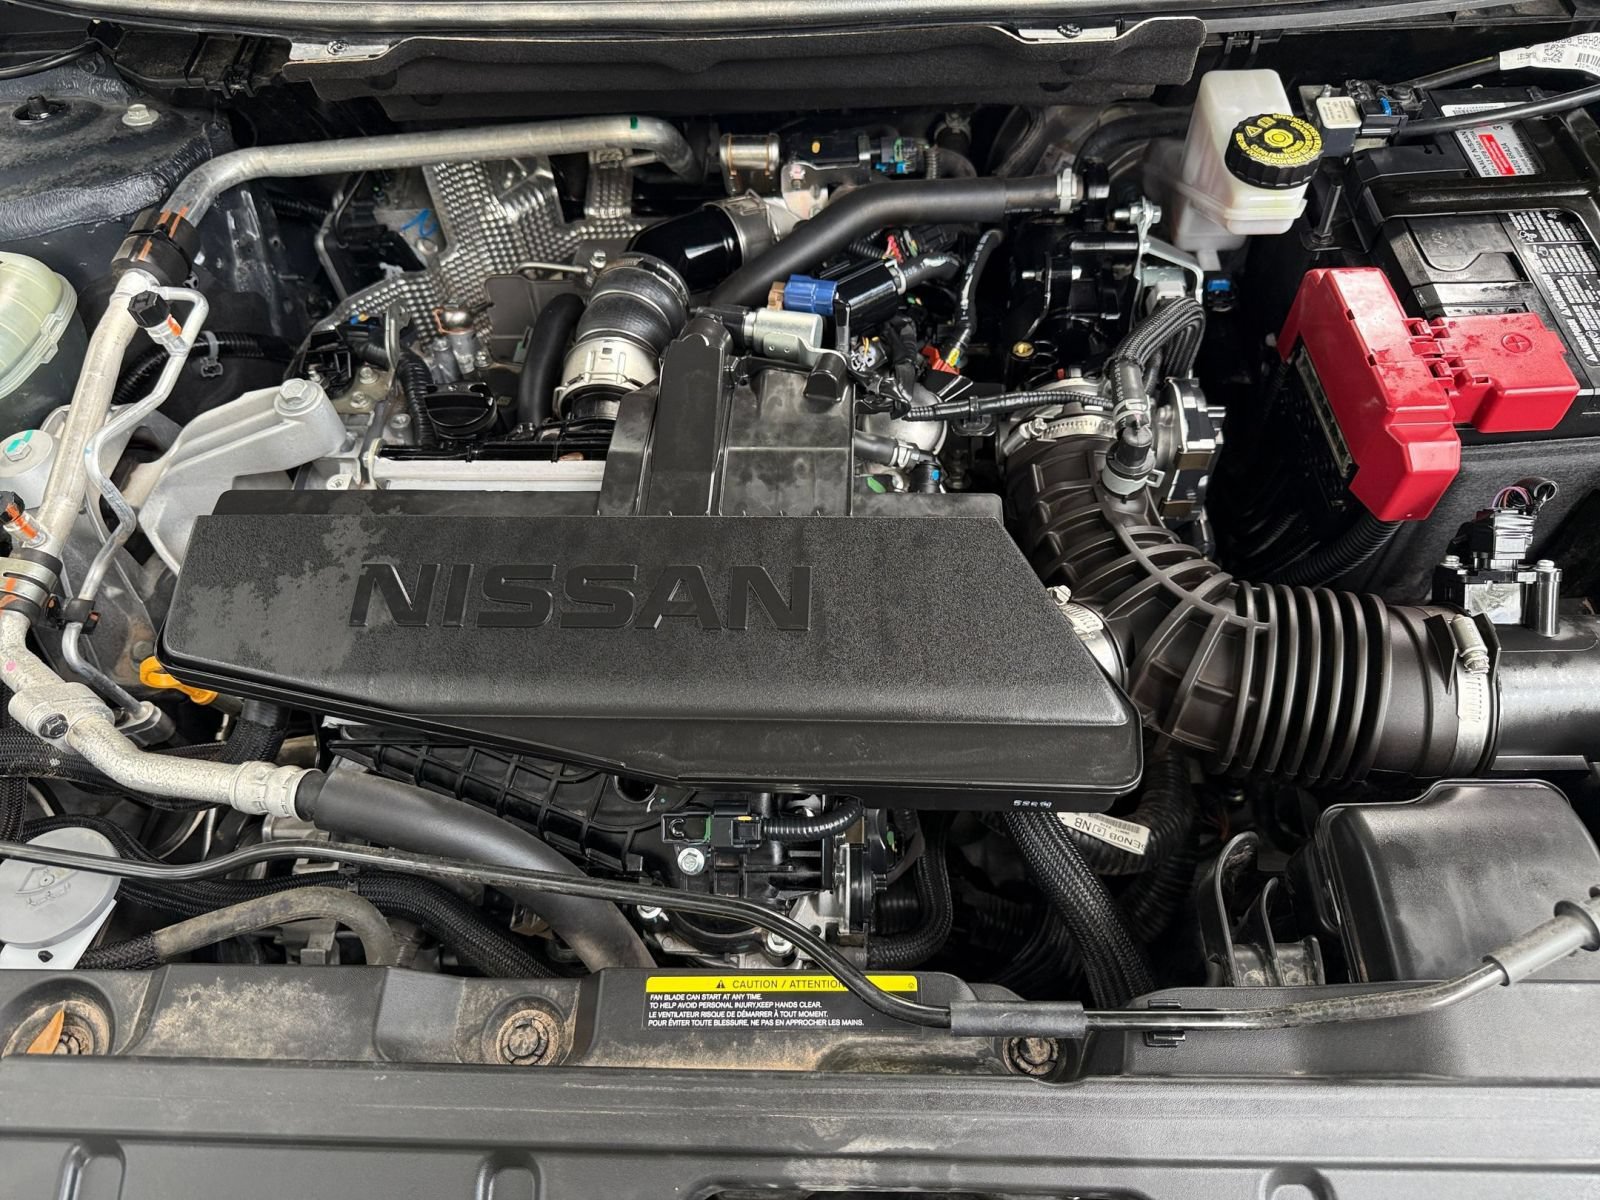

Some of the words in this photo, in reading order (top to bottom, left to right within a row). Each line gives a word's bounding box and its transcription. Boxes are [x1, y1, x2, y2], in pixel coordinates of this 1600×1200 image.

[349, 563, 812, 631] NISSAN
[732, 980, 778, 989] CAUTION
[650, 993, 663, 1001] FAN
[663, 993, 686, 1001] BLADE
[686, 993, 701, 1001] CAN
[701, 993, 722, 1001] START
[722, 993, 731, 1001] AT
[731, 993, 746, 1001] ANY
[746, 993, 763, 1001] TIME.
[650, 1001, 659, 1009] TO
[659, 1001, 677, 1009] HELP
[677, 1001, 698, 1009] AVOID
[698, 1001, 734, 1009] PERSONAL
[774, 1001, 798, 1009] HANDS
[798, 1001, 823, 1009] CLEAR.
[736, 1009, 773, 1018] DÉMARRER
[773, 1009, 779, 1018] À
[648, 1019, 668, 1027] POUR
[668, 1017, 691, 1027] ÉVITER
[691, 1019, 713, 1027] TOUTE
[750, 1019, 760, 1027] NE
[761, 1019, 775, 1027] PAS
[775, 1019, 785, 1027] EN
[785, 1019, 828, 1027] APPROCHER
[828, 1019, 841, 1027] LES
[841, 1019, 865, 1027] MAINS.
